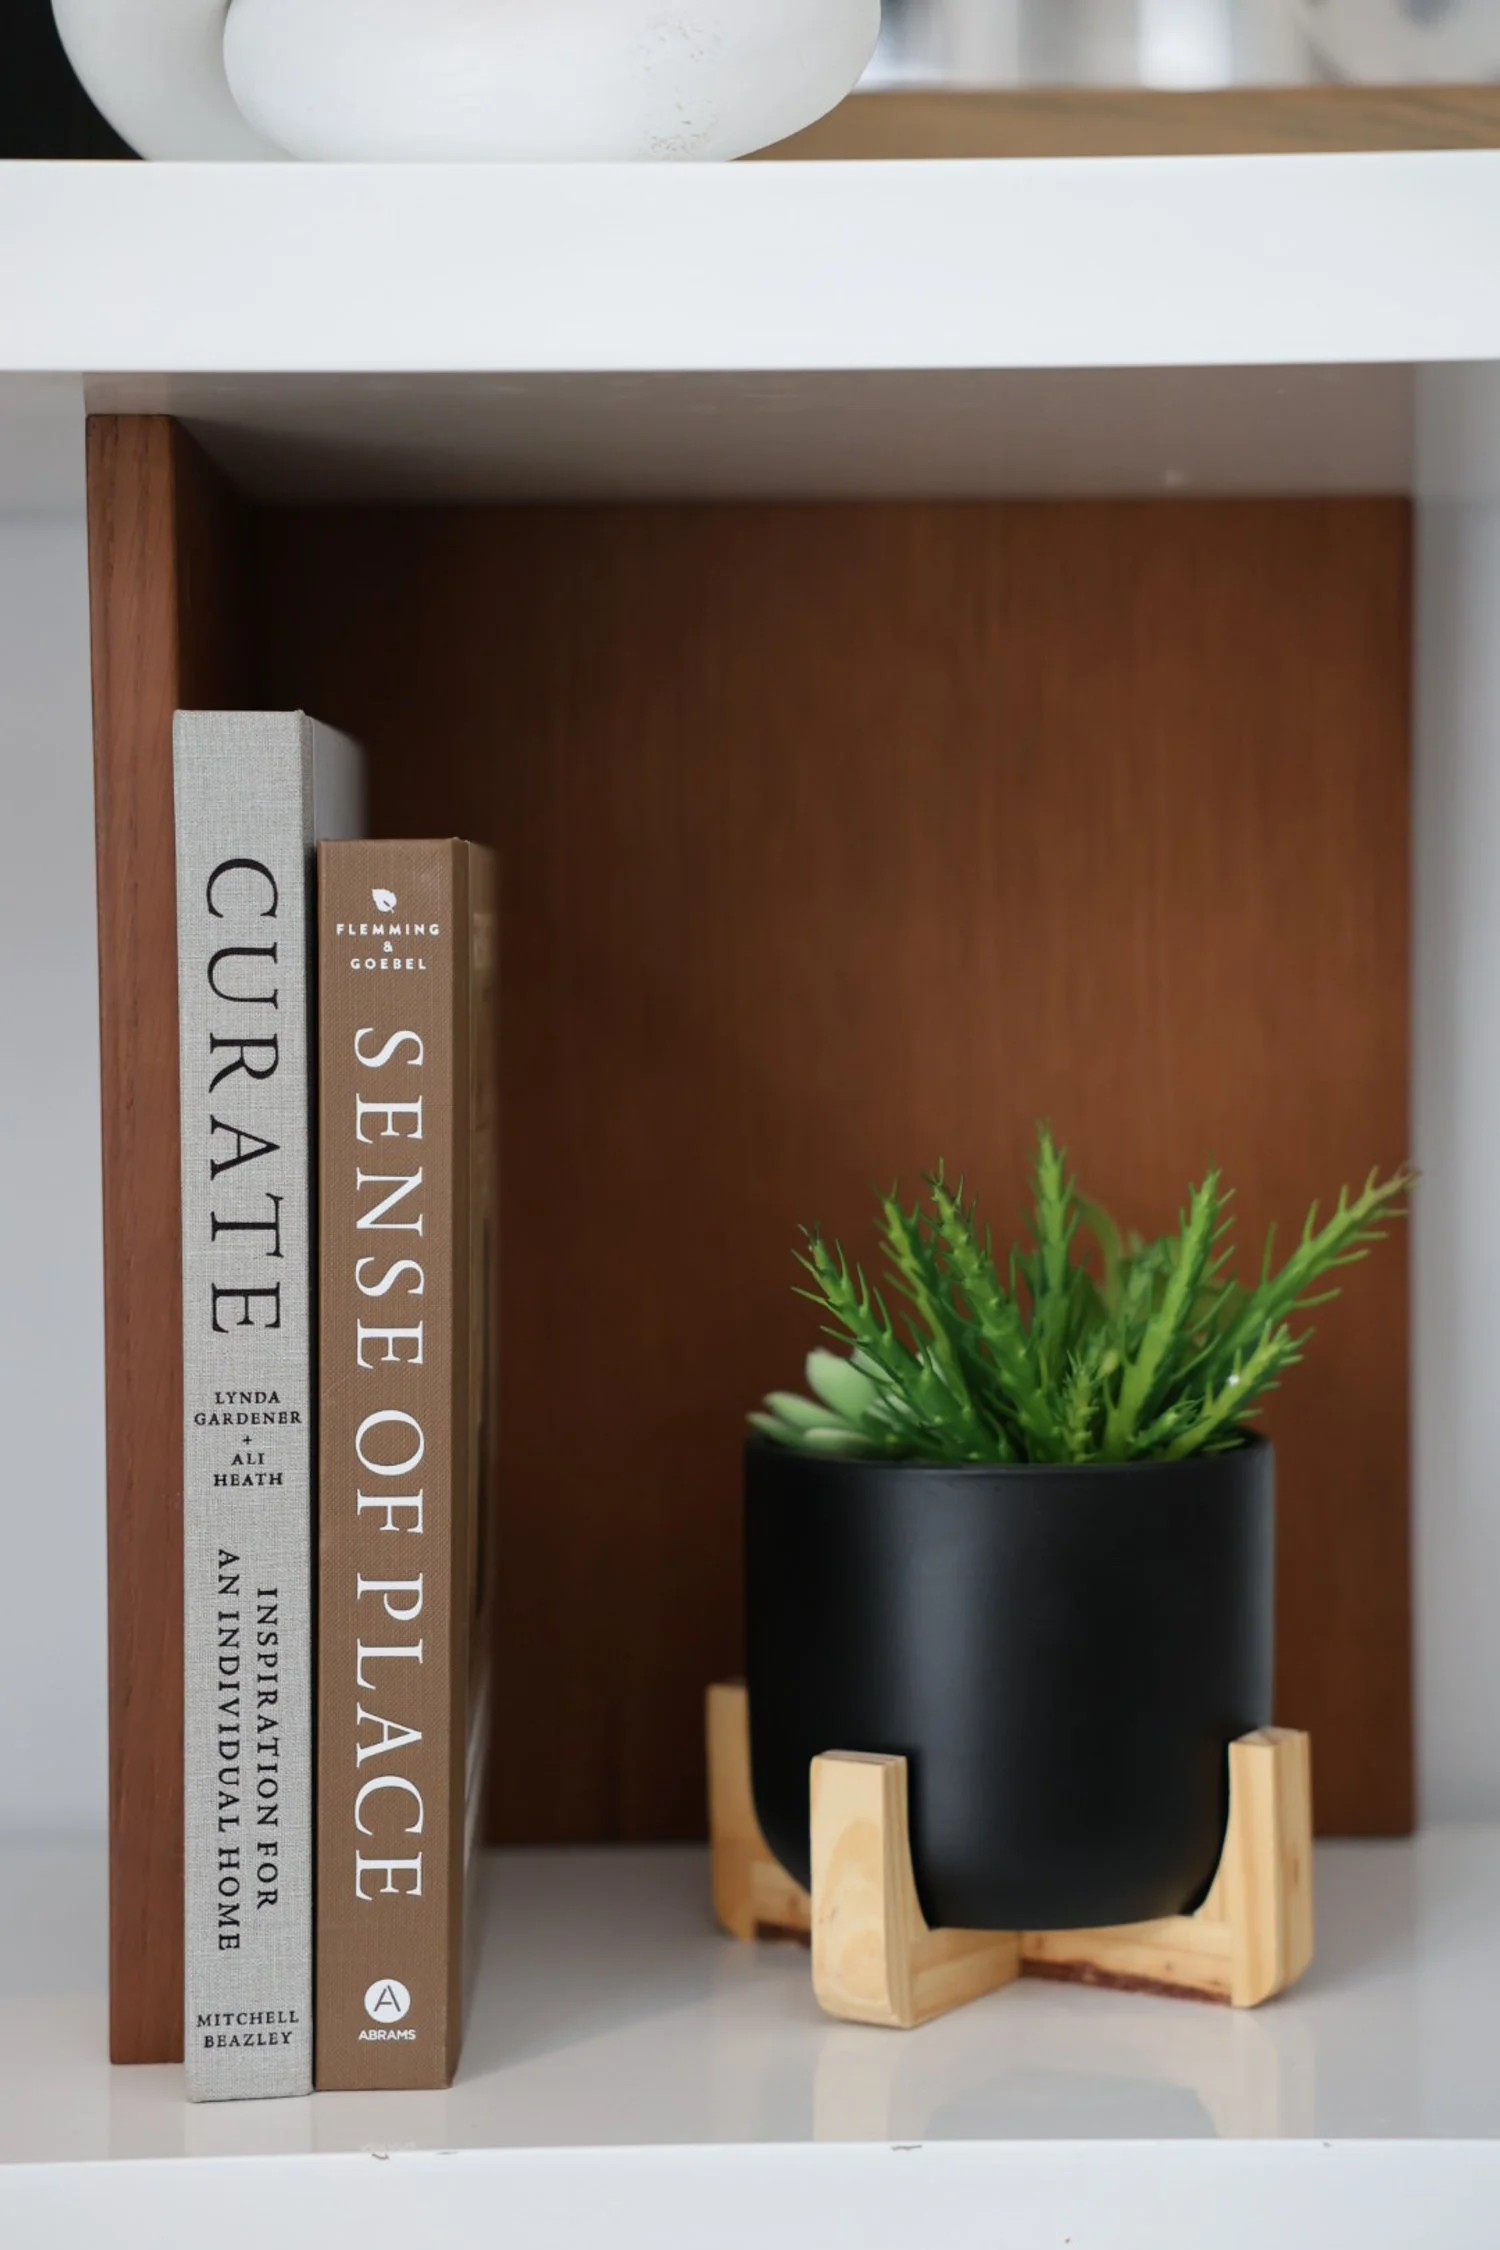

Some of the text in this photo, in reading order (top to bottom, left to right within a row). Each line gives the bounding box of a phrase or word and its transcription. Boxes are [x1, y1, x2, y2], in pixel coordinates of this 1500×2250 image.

[336, 923, 440, 936] FLEMMING
[383, 941, 393, 953] &
[350, 958, 427, 970] GOEBEL
[206, 858, 284, 1334] CURATE
[215, 1391, 280, 1404] LYNDA
[194, 1411, 301, 1425] GARDENER
[243, 1436, 252, 1445] +
[231, 1453, 265, 1466] ALI
[354, 1027, 424, 1901] SENSE OF PLACE
[213, 1472, 283, 1487] HEATH
[218, 1549, 241, 1951] AN INDIVIDUAL HOME
[256, 1587, 280, 1910] INSPIRATION FOR
[373, 1985, 402, 2012] A
[196, 2010, 299, 2028] MITCHELL
[204, 2031, 293, 2048] BEAZLEY
[358, 2029, 416, 2041] ABRAMS
